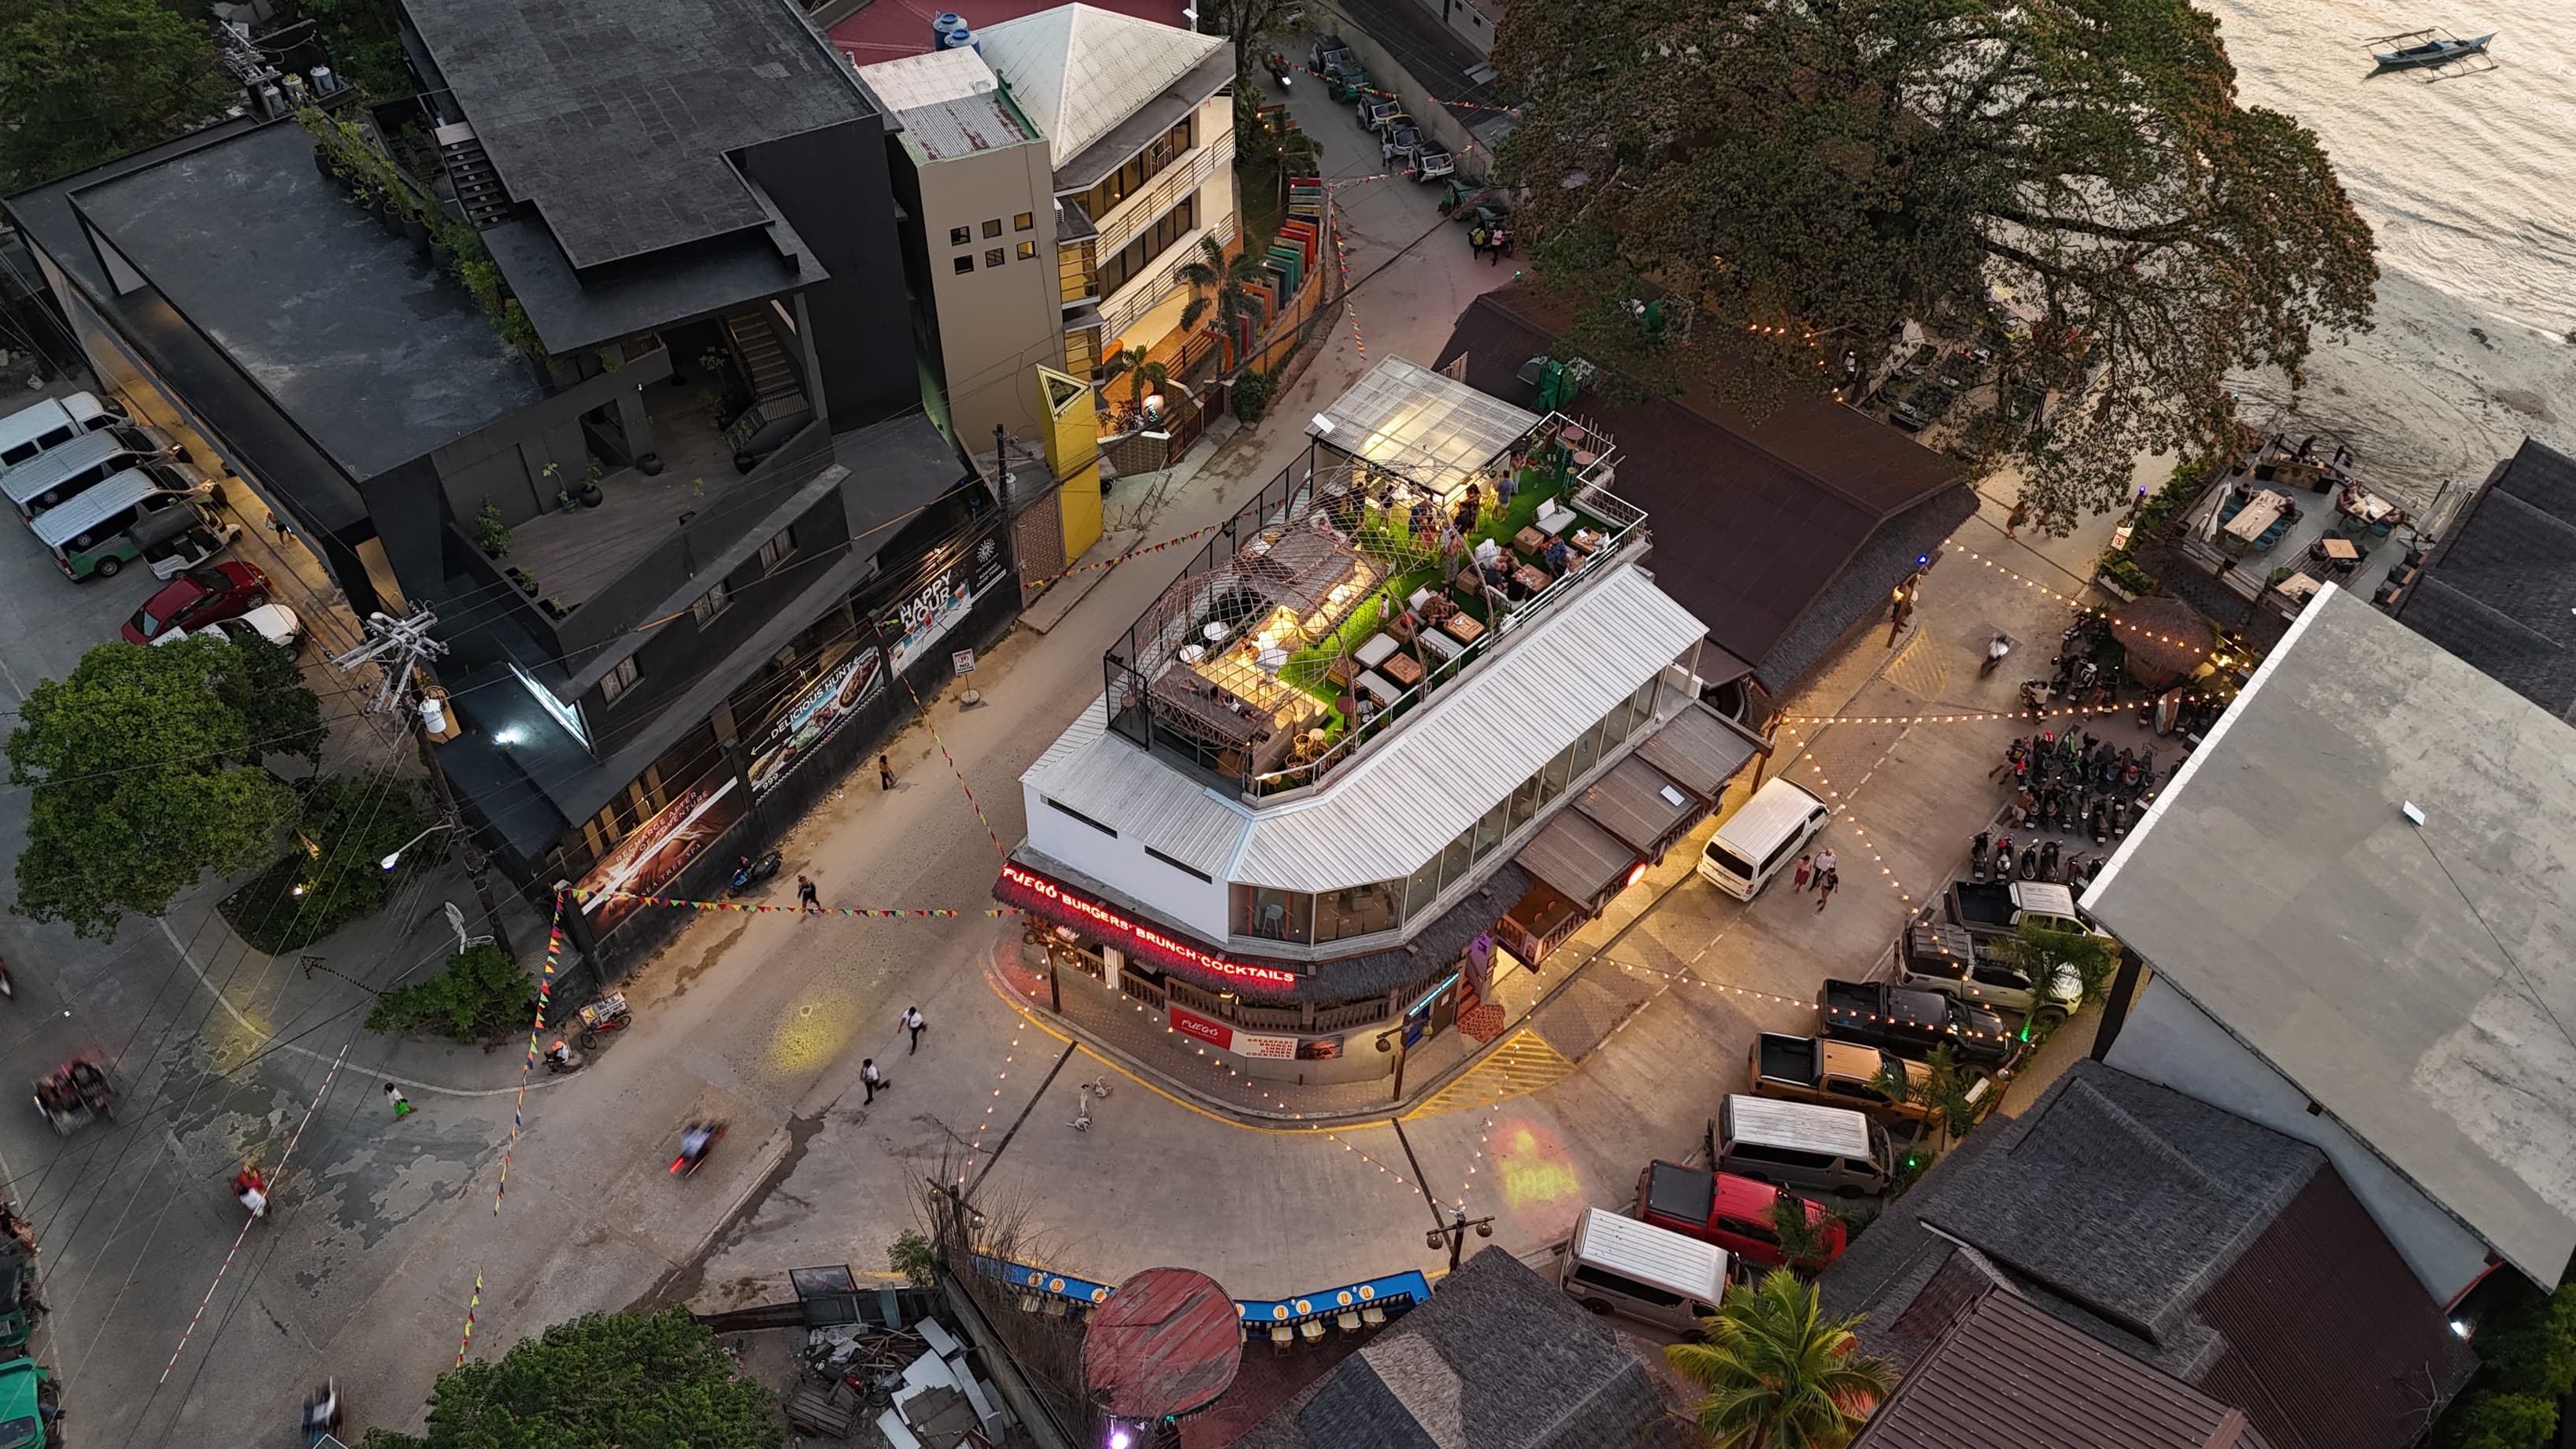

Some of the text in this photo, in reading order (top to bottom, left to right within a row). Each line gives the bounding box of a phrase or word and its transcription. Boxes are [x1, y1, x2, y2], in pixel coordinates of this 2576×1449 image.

[900, 569, 951, 623] HAPPY
[905, 586, 950, 630] HOUR
[771, 662, 852, 740] DELICIOUS HUNT
[616, 818, 666, 863] RECHARGE
[668, 791, 698, 819] AFTER
[639, 838, 651, 852] OF
[655, 790, 708, 838] ADVENTURE
[661, 860, 683, 881] TREE
[686, 843, 702, 859] SPA
[1061, 893, 1130, 930] BURGERS
[1135, 927, 1197, 961] BRUNCH
[1201, 956, 1295, 982] COCKTAILS
